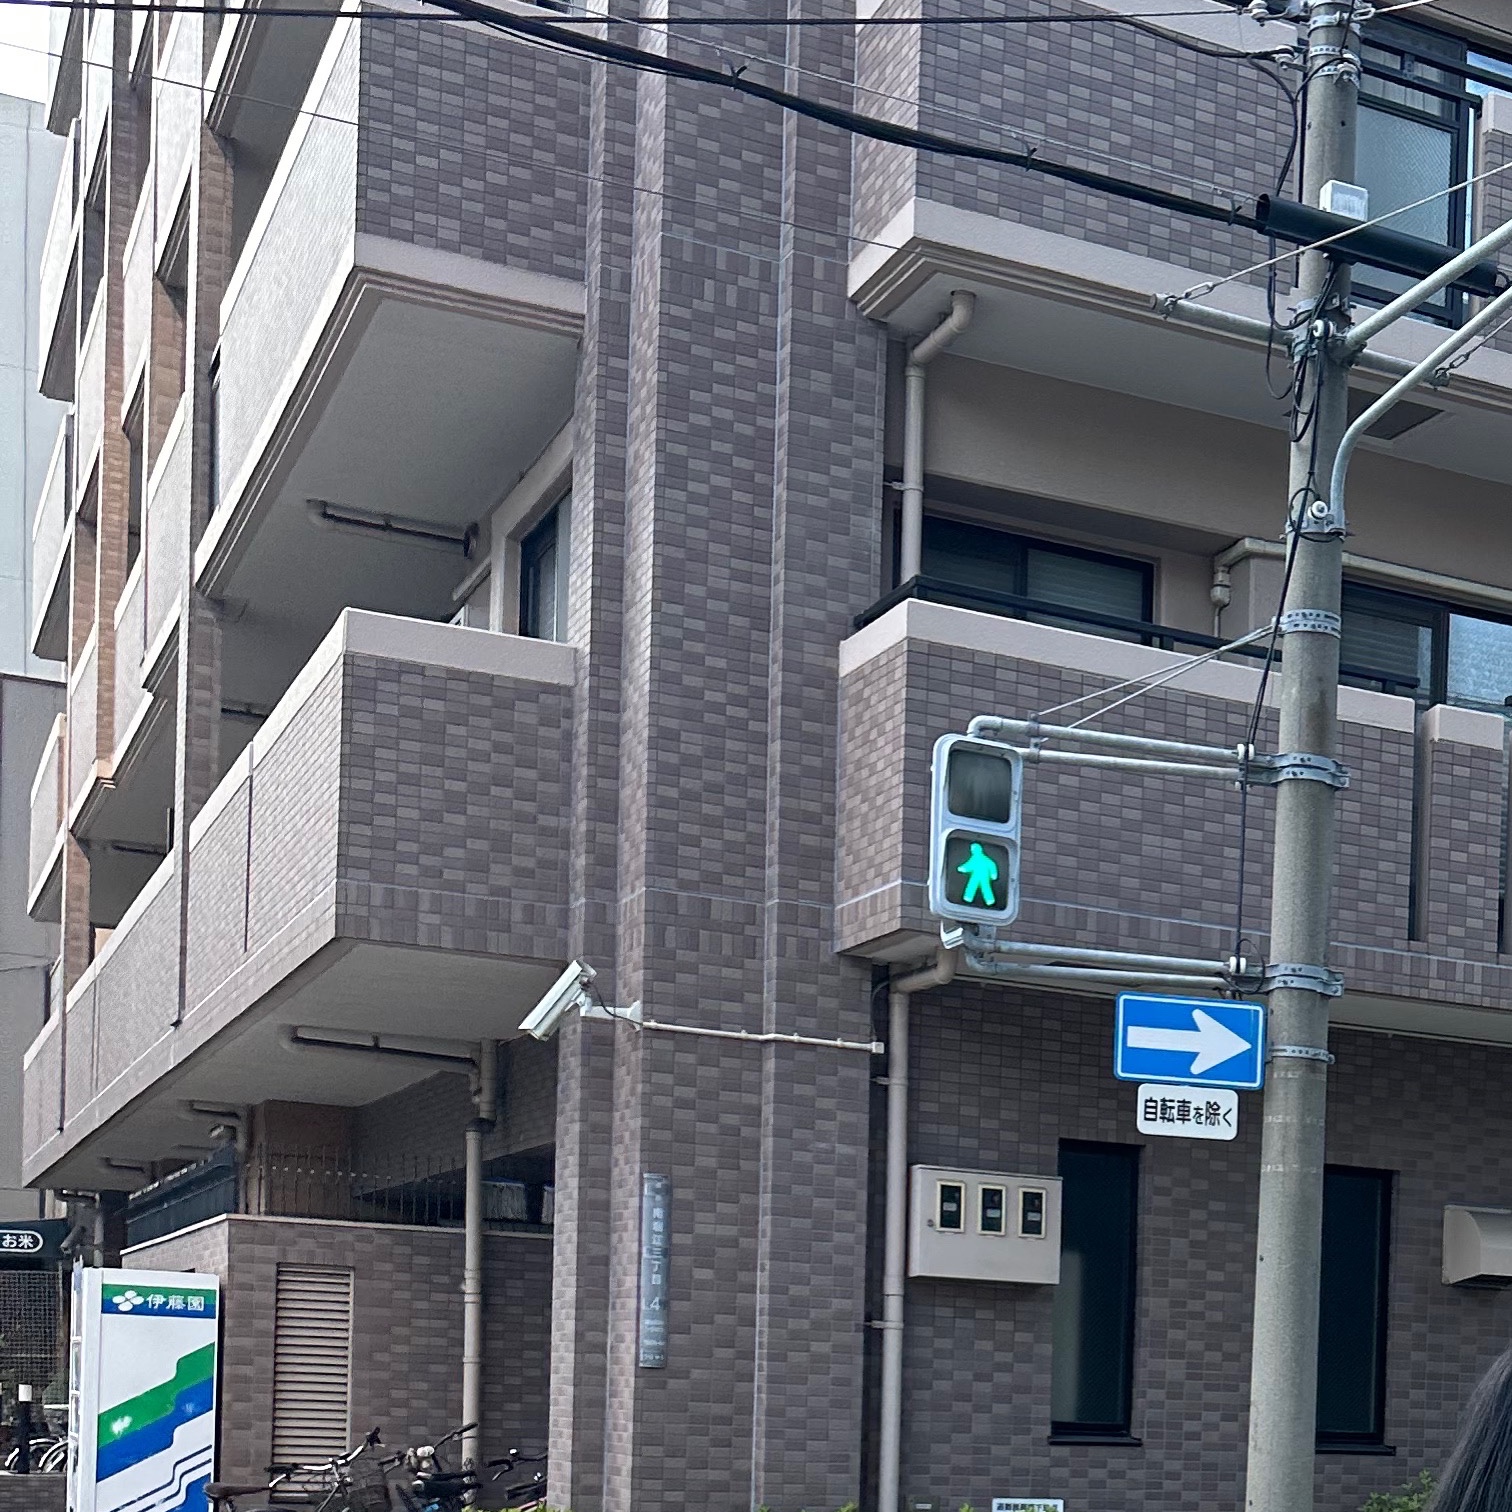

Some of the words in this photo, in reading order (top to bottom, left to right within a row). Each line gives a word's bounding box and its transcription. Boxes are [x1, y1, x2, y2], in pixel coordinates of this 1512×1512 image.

[1144, 1097, 1232, 1127] 自転車を除く
[2, 1233, 34, 1249] お米
[146, 1294, 204, 1311] 伊藤園
